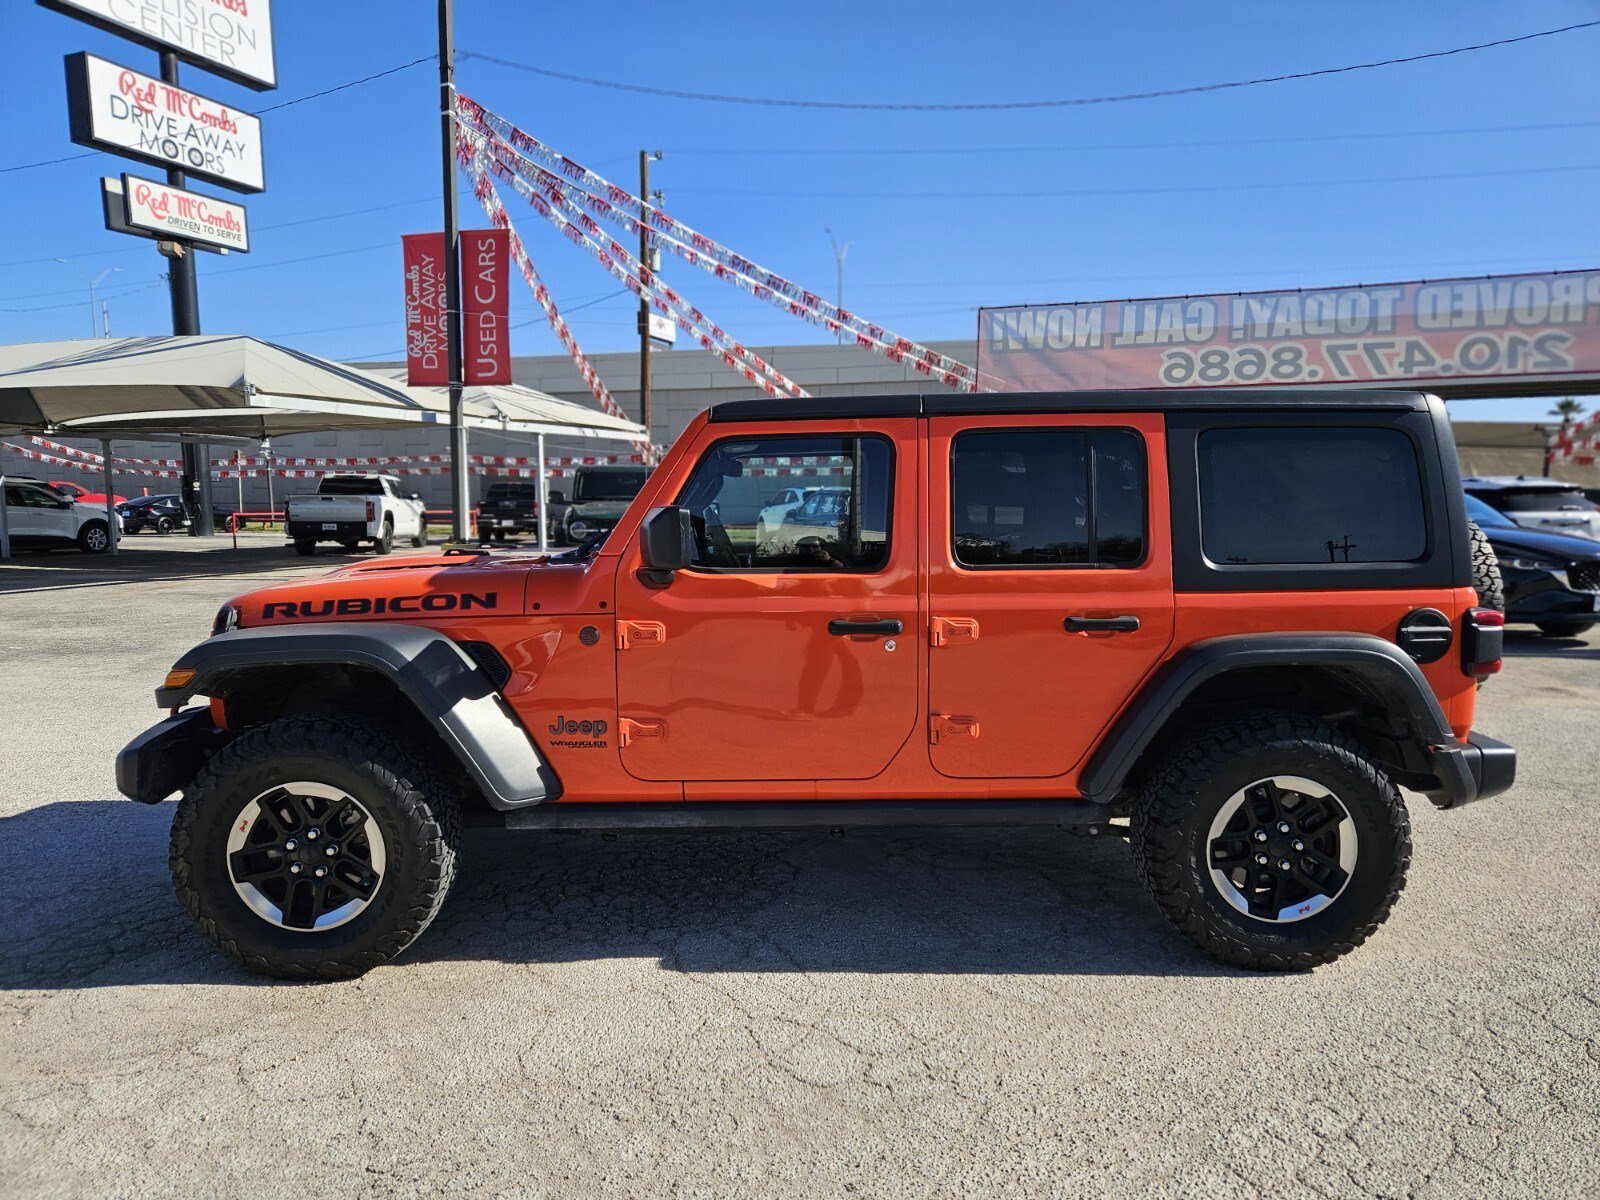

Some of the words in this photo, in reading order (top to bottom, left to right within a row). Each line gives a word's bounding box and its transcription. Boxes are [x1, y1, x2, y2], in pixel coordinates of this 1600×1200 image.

[109, 0, 236, 66] CENTER
[110, 94, 178, 139] DRIVE
[184, 123, 246, 160] AWAY
[118, 70, 157, 114] Red
[160, 83, 238, 135] McCombs
[139, 129, 225, 175] MOTORS
[135, 184, 170, 220] Red
[170, 193, 241, 233] McCombs
[167, 215, 201, 232] DRIVEN
[203, 225, 215, 235] TO
[216, 228, 242, 242] SERVE
[405, 265, 421, 328] McCombs
[420, 253, 437, 310] AWAY
[474, 238, 496, 304] CARS
[407, 330, 427, 358] Red
[421, 315, 438, 369] DRIVE
[477, 310, 498, 377] USED
[262, 592, 498, 619] RUBICON
[549, 715, 607, 738] Jeep
